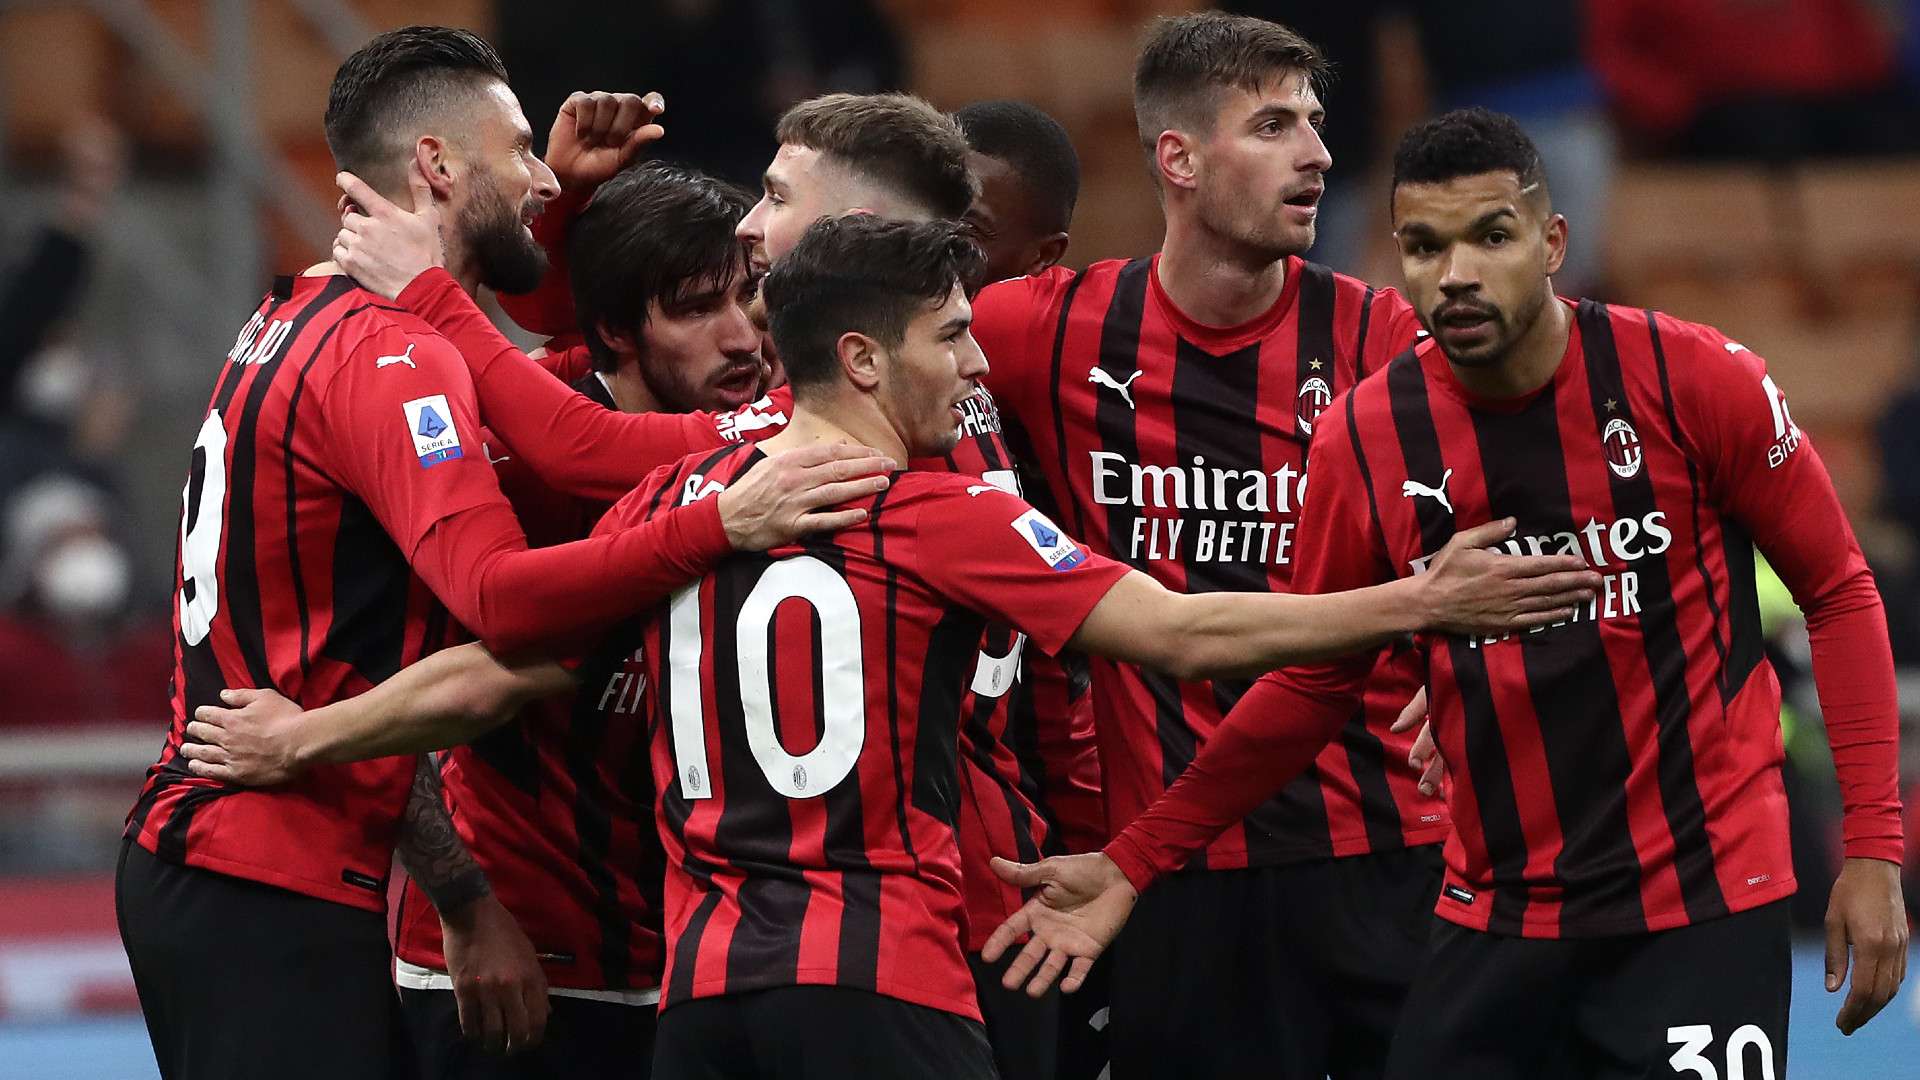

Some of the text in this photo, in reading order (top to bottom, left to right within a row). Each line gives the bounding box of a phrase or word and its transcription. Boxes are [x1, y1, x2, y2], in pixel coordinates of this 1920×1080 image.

[420, 439, 446, 453] SERIE
[179, 408, 228, 647] 9
[1131, 517, 1295, 565] FLY BETTE
[597, 672, 647, 714] FLY
[669, 555, 866, 800] 10
[1666, 1024, 1776, 1080] 30
